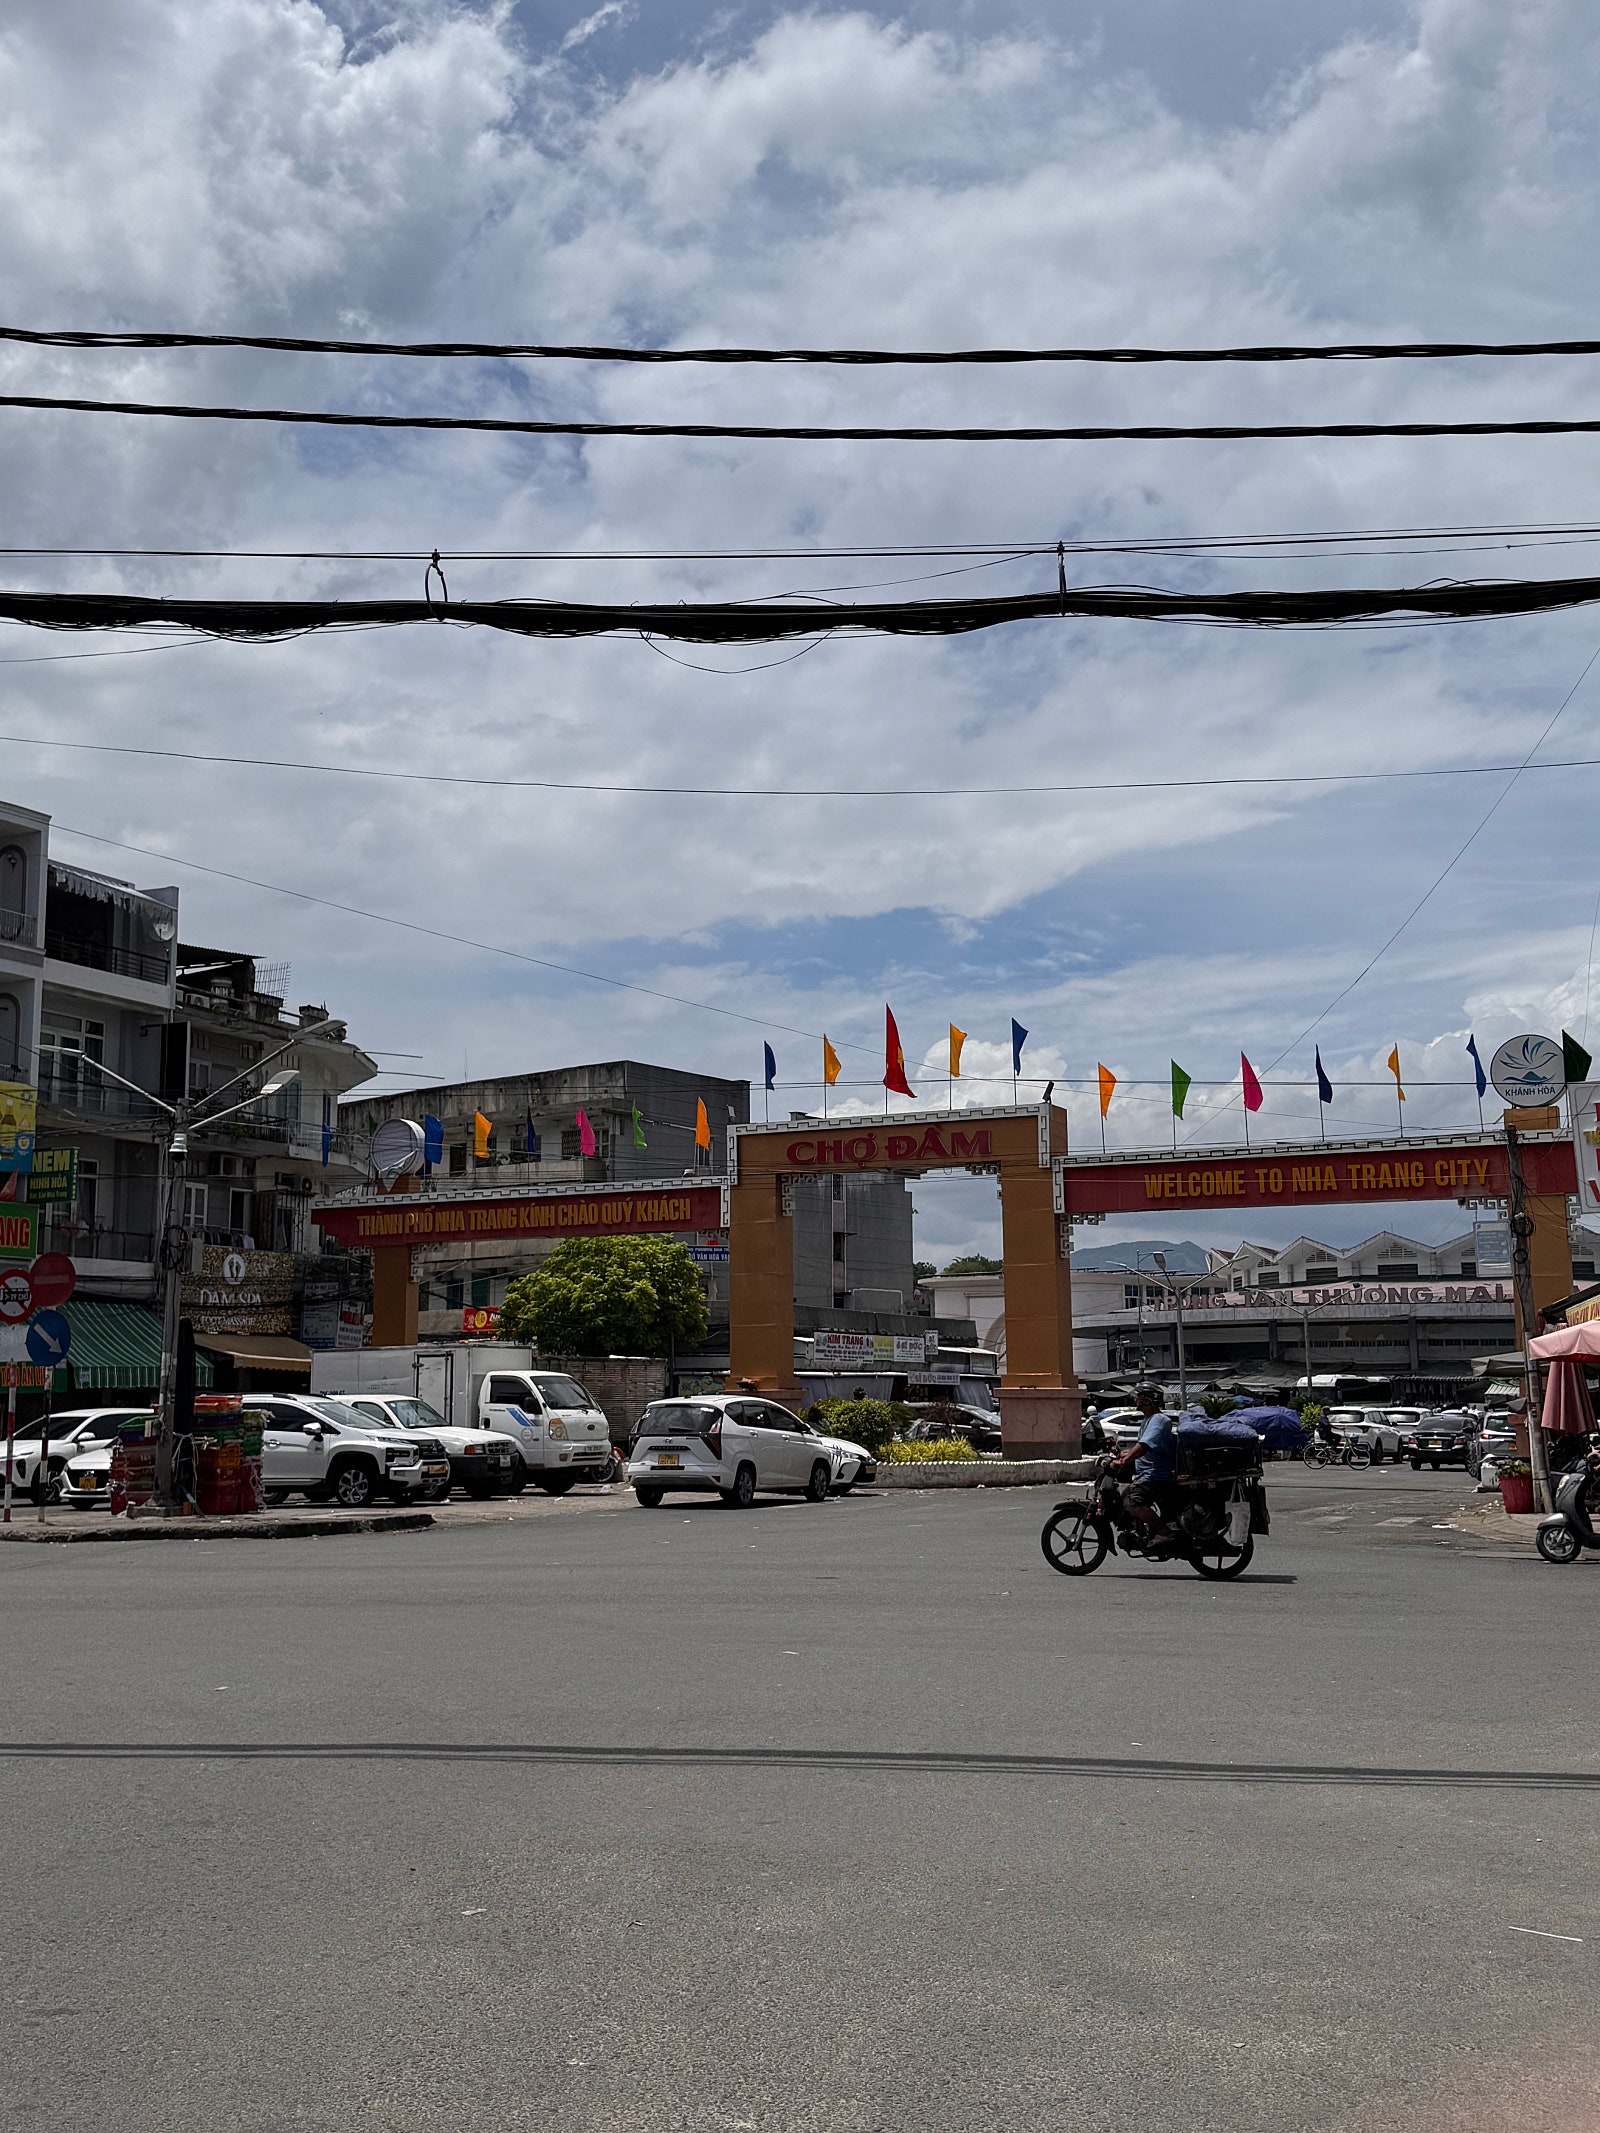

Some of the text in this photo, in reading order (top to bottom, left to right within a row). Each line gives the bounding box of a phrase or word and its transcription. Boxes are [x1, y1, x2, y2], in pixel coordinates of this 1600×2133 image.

[1505, 1085, 1556, 1096] KHÁNH HÒA
[787, 1123, 991, 1167] CHỢ ĐẦM
[32, 1150, 70, 1173] NEM
[1144, 1158, 1489, 1198] WELCOME TO NHA TRANG CITY
[357, 1195, 691, 1236] THÀNH PHỐ NHA TRANG KÍNH CHÀO QUÝ KHÁCH
[1150, 1294, 1226, 1310] TRUNG
[827, 1334, 864, 1346] KIM TRANG
